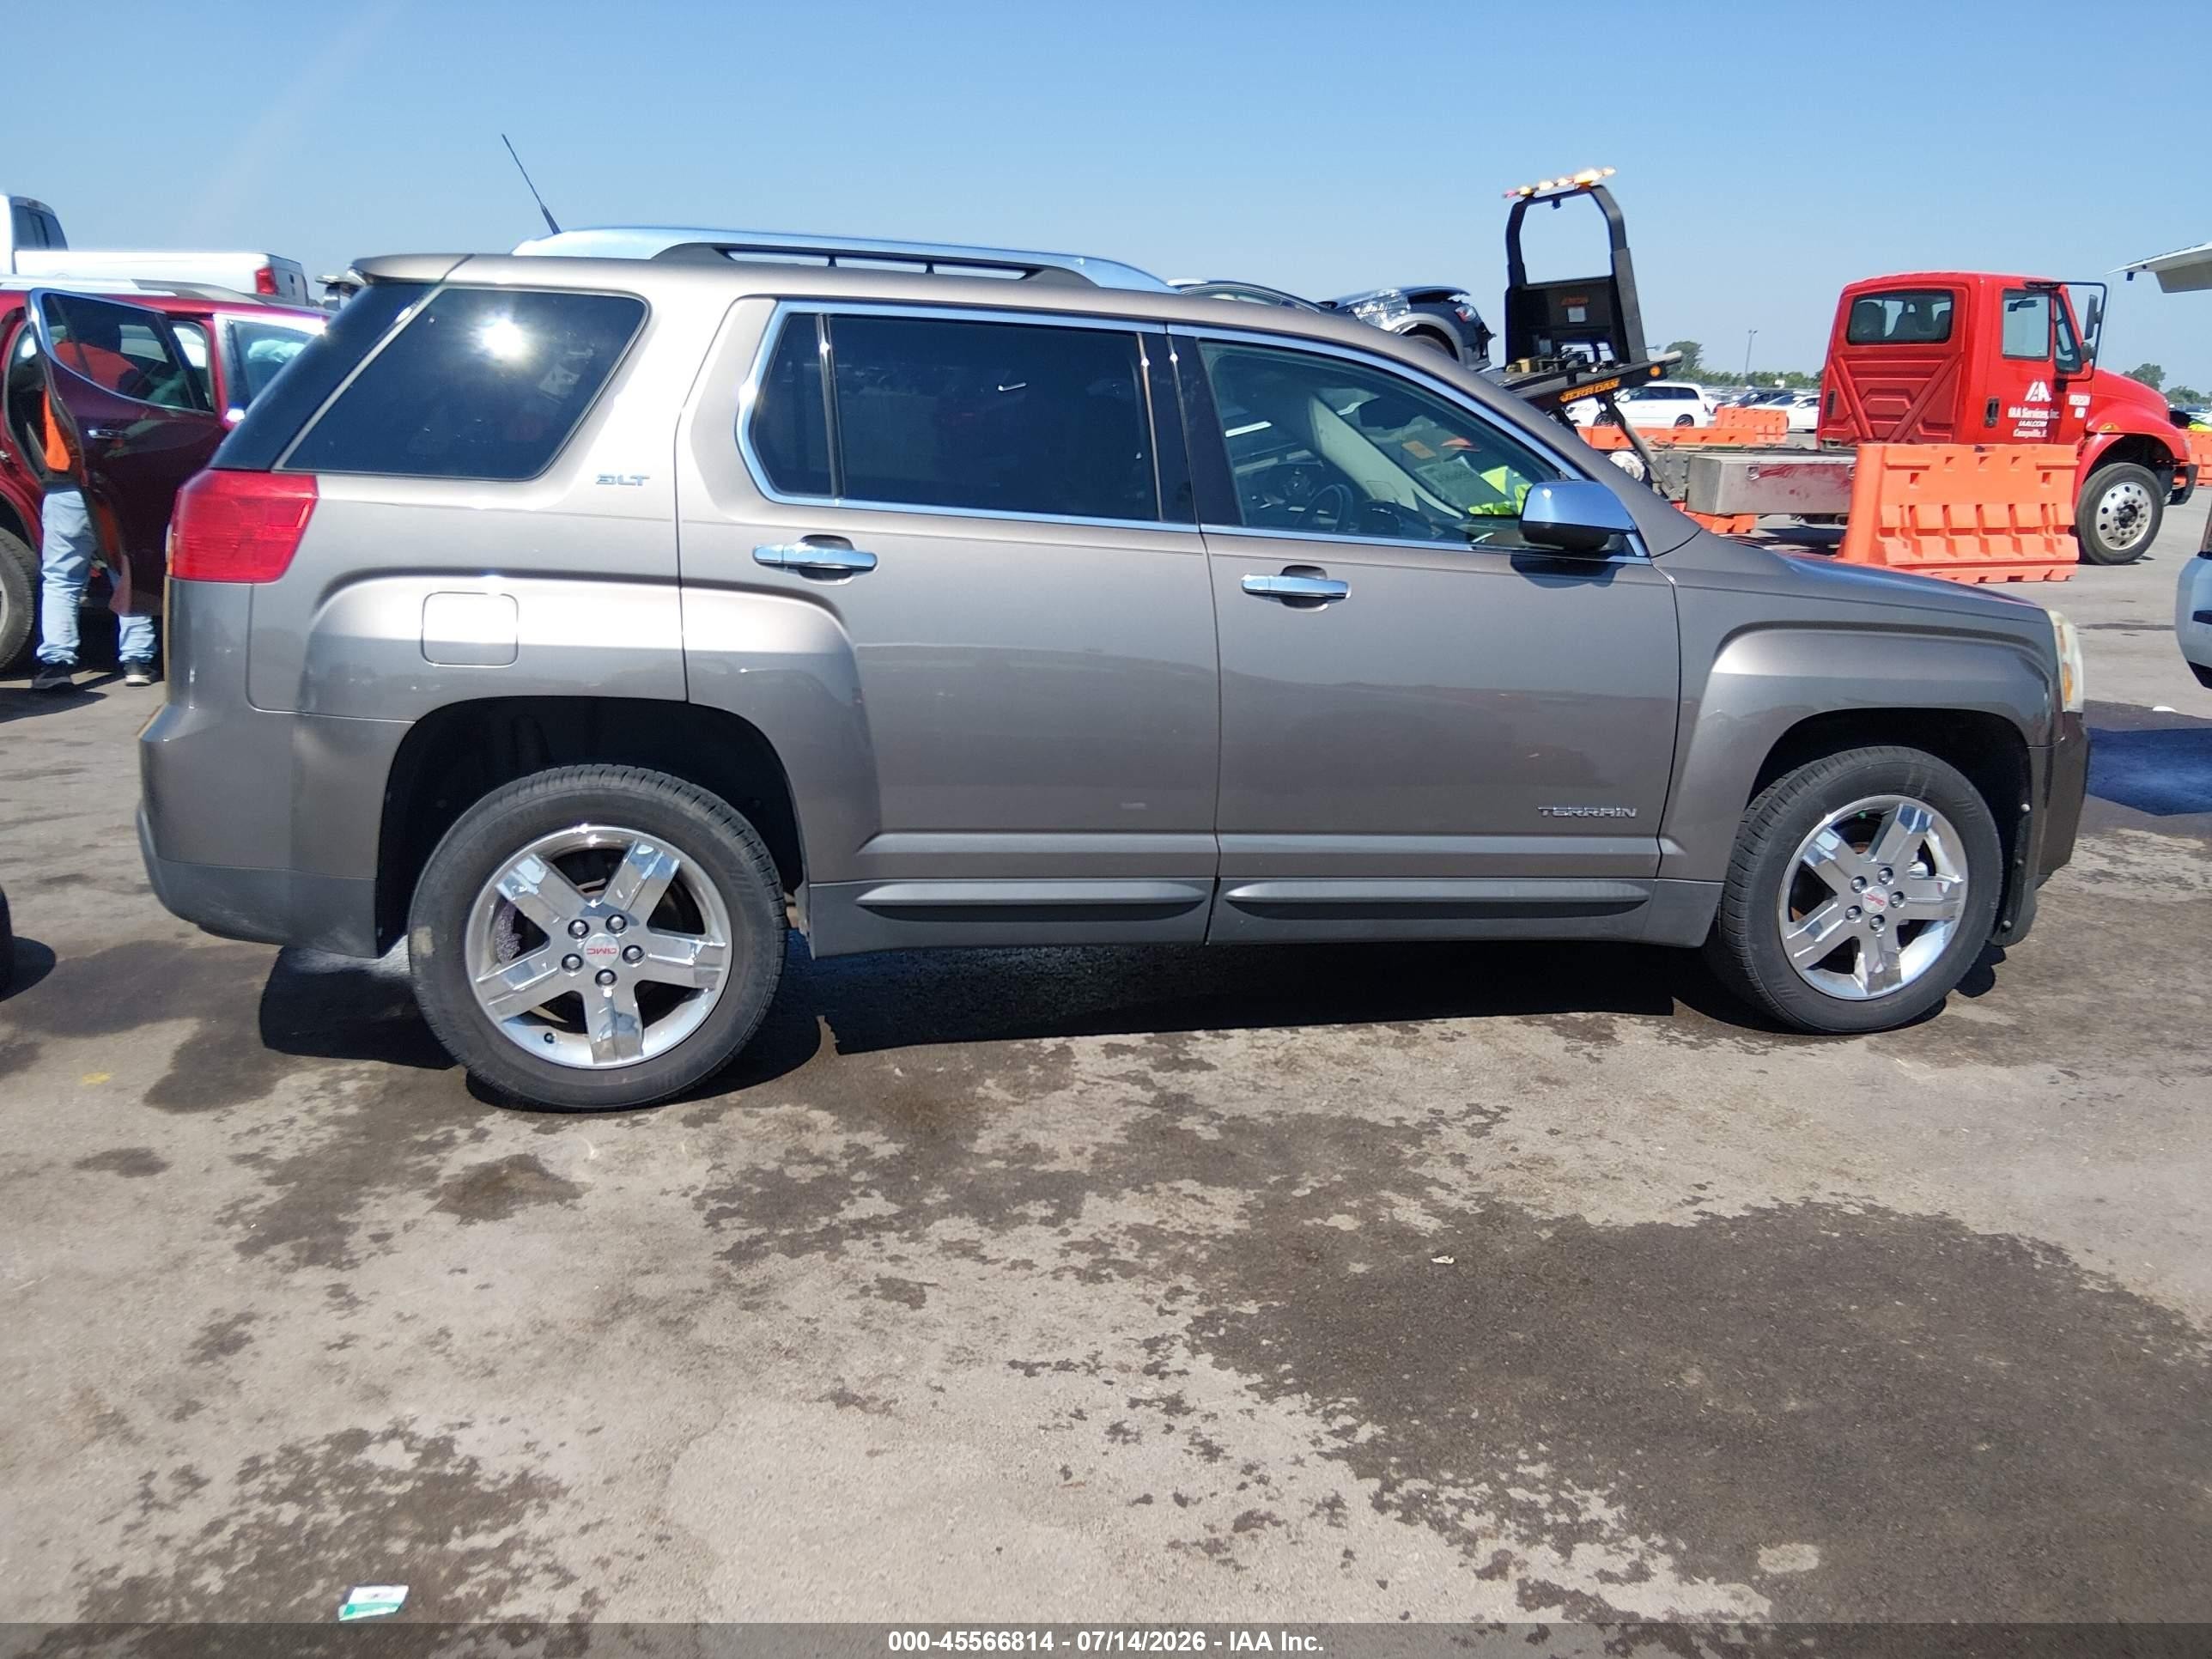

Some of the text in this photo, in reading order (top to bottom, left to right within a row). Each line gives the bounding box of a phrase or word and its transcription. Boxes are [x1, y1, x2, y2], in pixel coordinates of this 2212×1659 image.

[596, 474, 650, 486] SLT
[1537, 806, 1638, 818] TERRAIN
[586, 947, 617, 956] GMC
